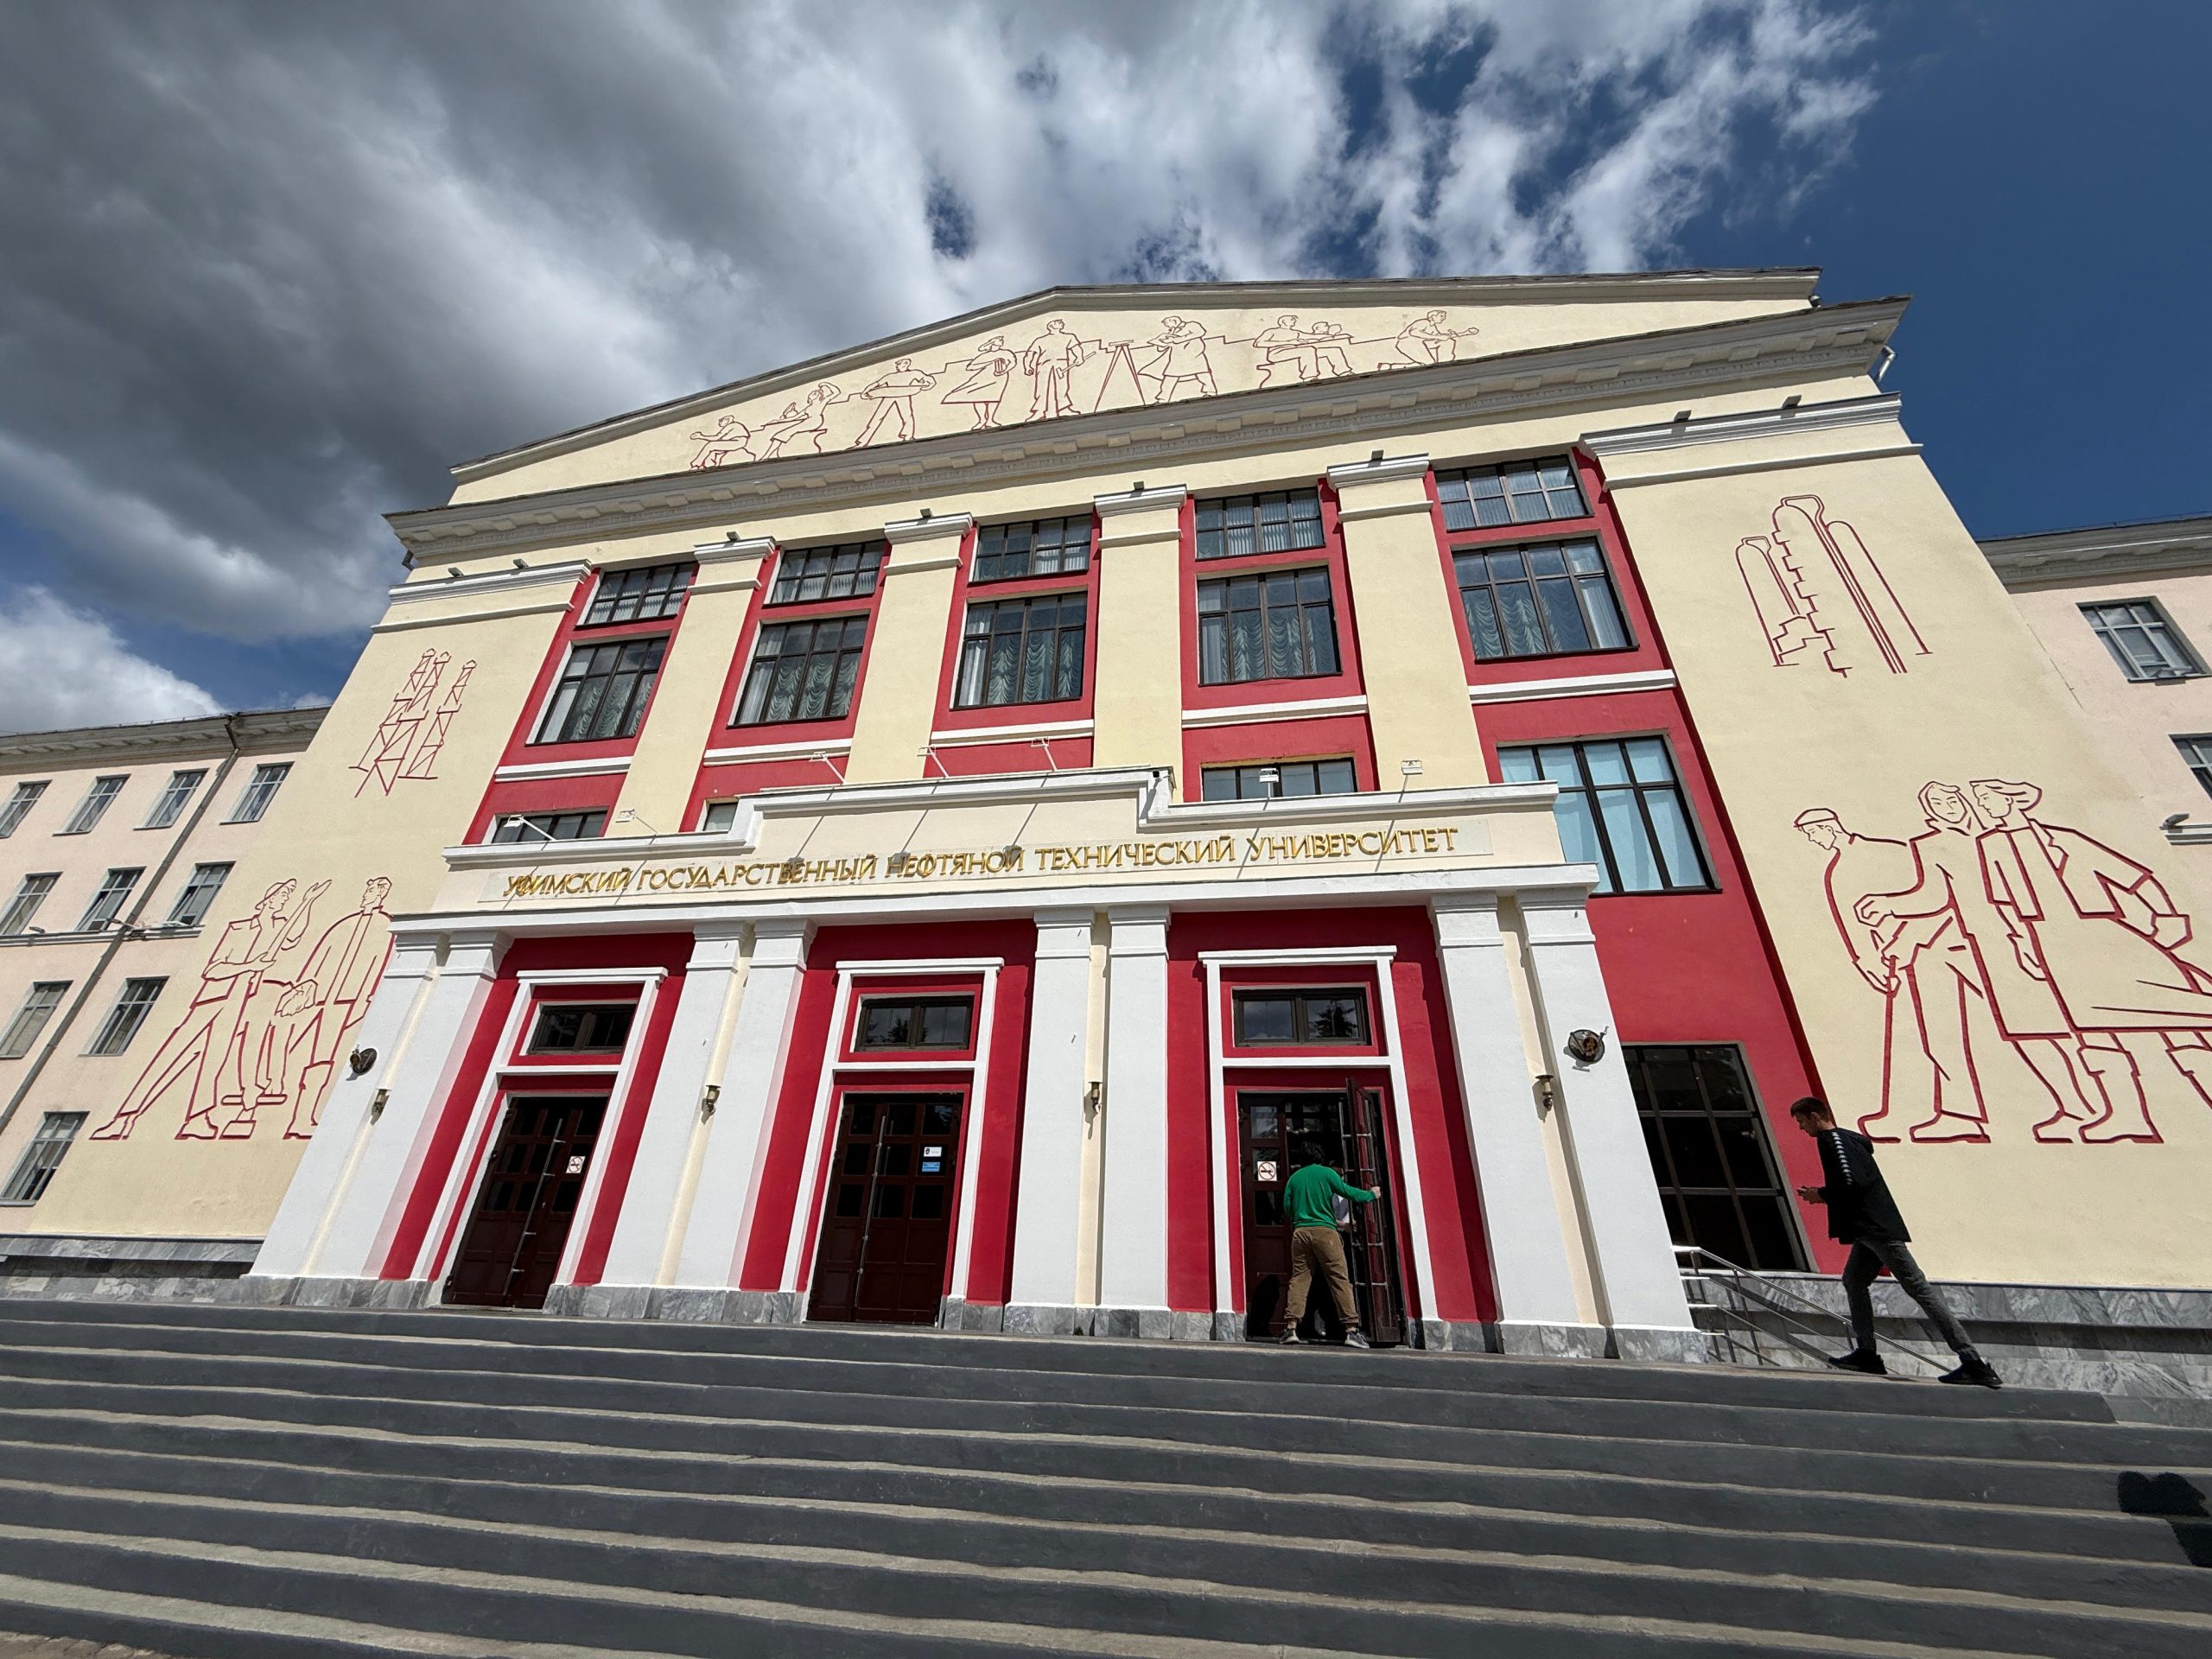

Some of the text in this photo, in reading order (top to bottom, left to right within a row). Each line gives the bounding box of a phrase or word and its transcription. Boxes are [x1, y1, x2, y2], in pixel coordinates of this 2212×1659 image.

[503, 827, 1458, 897] УФИМСКИЙ ГОСУДАРСТВЕННЫЙ НЕФТЯНОЙ ТЕХНИЧЕСКИЙ УНИВЕРСИТЕТ
